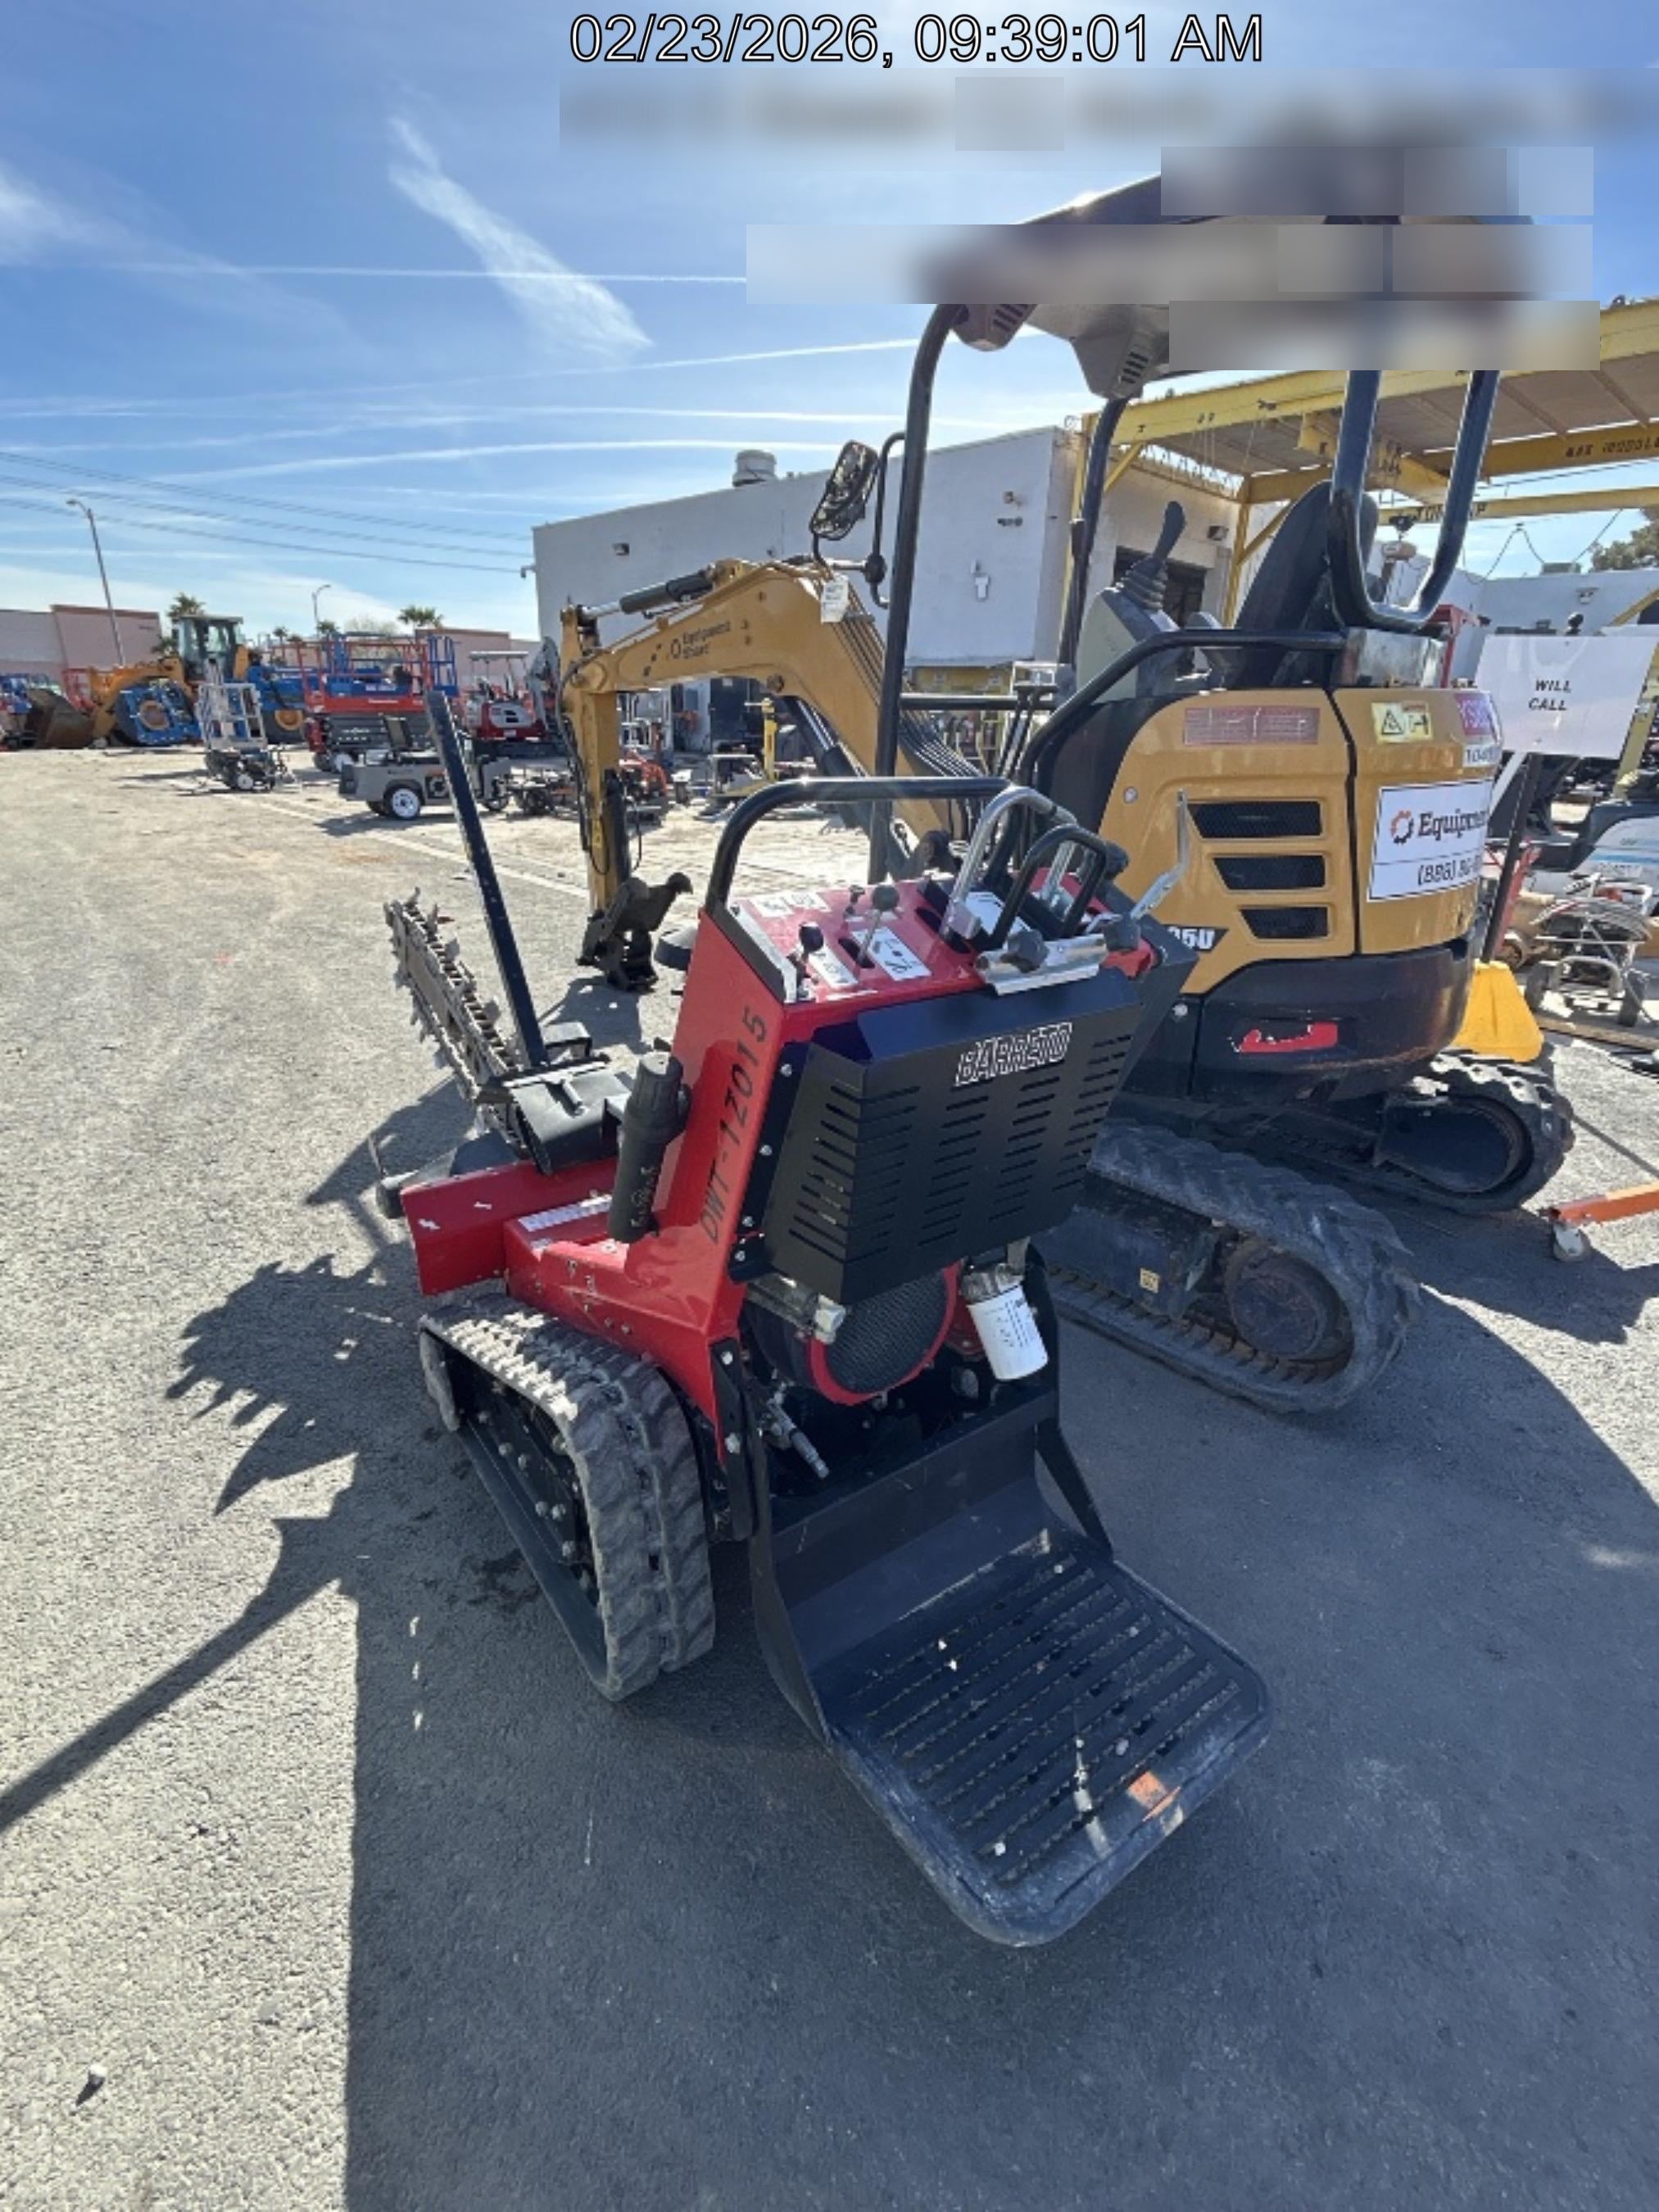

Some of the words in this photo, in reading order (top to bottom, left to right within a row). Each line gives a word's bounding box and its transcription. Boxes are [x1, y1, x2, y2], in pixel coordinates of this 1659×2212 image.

[1535, 679, 1571, 693] WILL
[1528, 697, 1567, 711] CALL
[954, 1022, 1073, 1087] BARRETO
